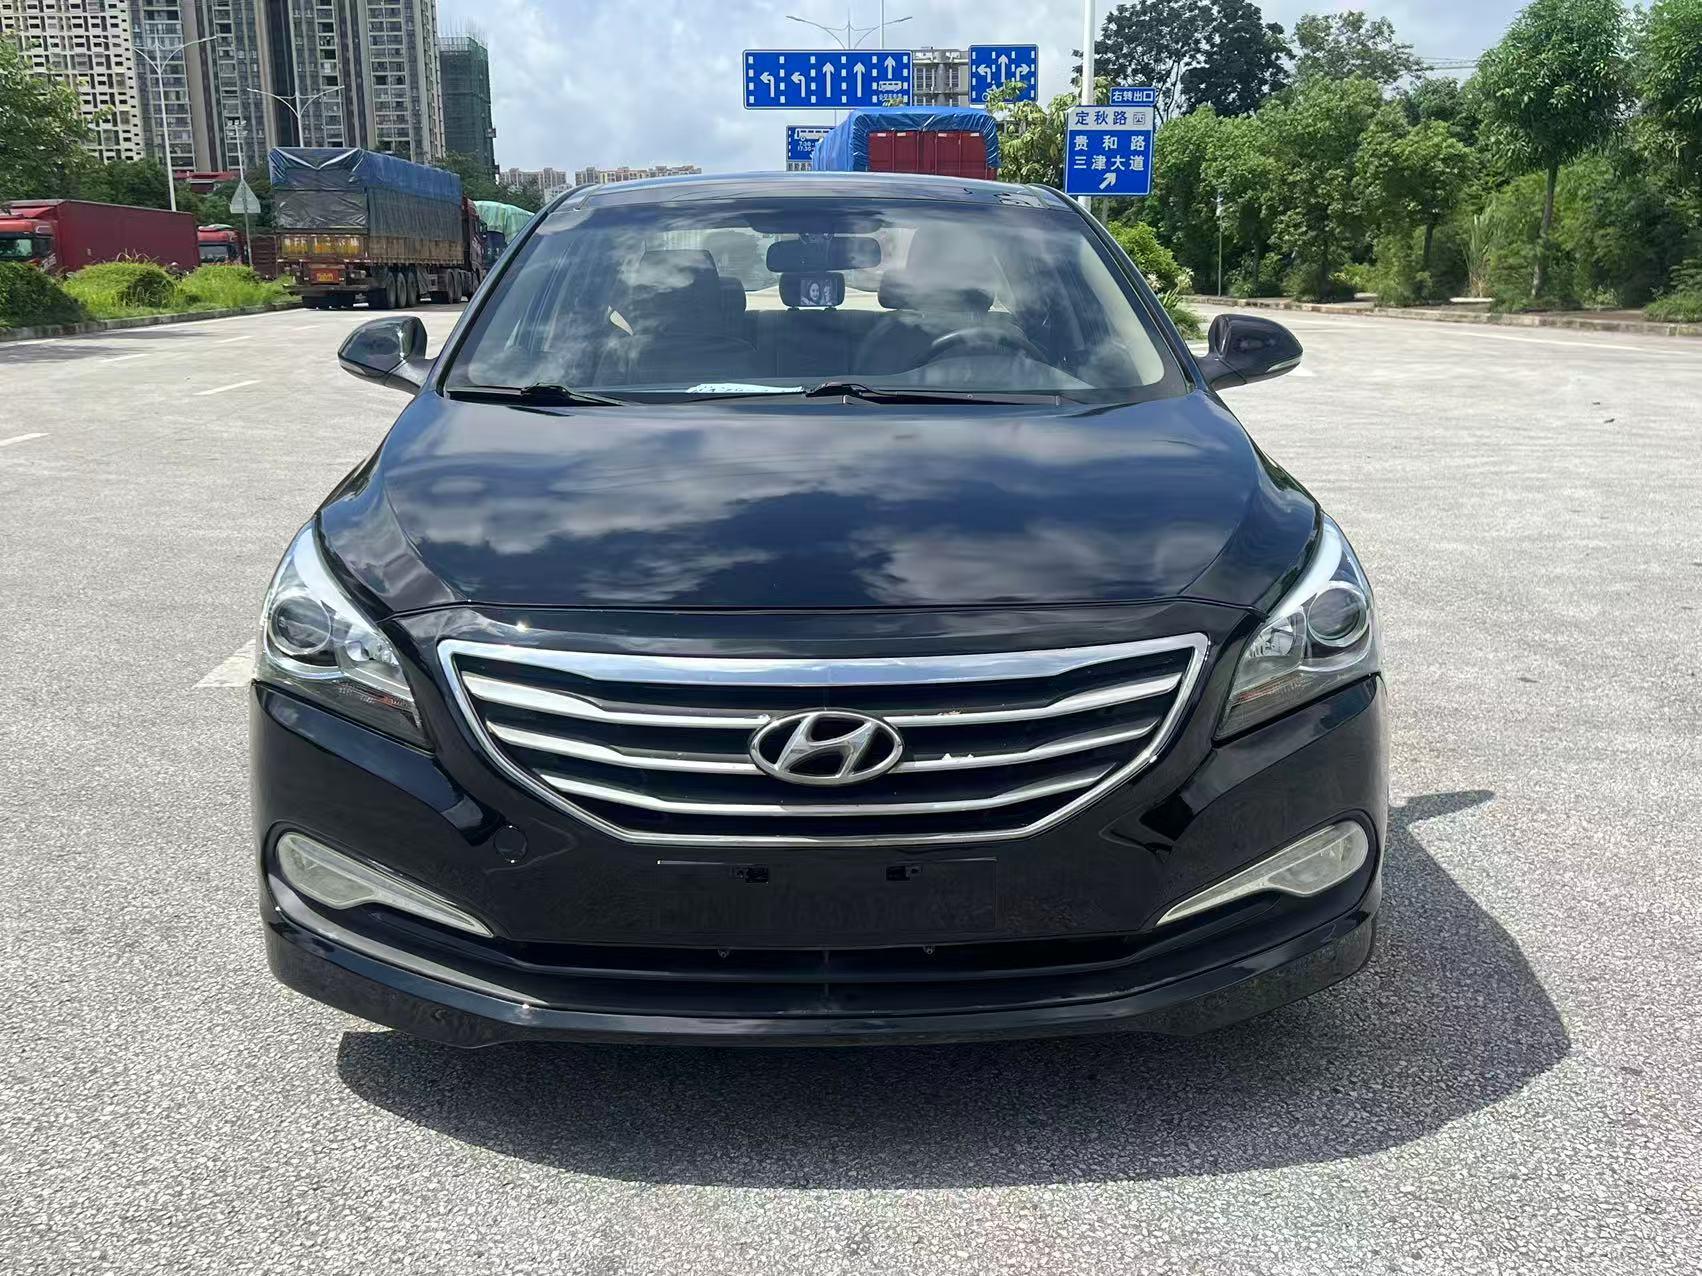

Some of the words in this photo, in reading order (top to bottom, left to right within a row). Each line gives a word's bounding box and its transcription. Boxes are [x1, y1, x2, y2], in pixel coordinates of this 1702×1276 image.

[1112, 90, 1154, 102] 右转出口
[1075, 111, 1128, 125] 定秋路
[1074, 135, 1145, 151] 贵和路
[1073, 155, 1145, 171] 三津大道
